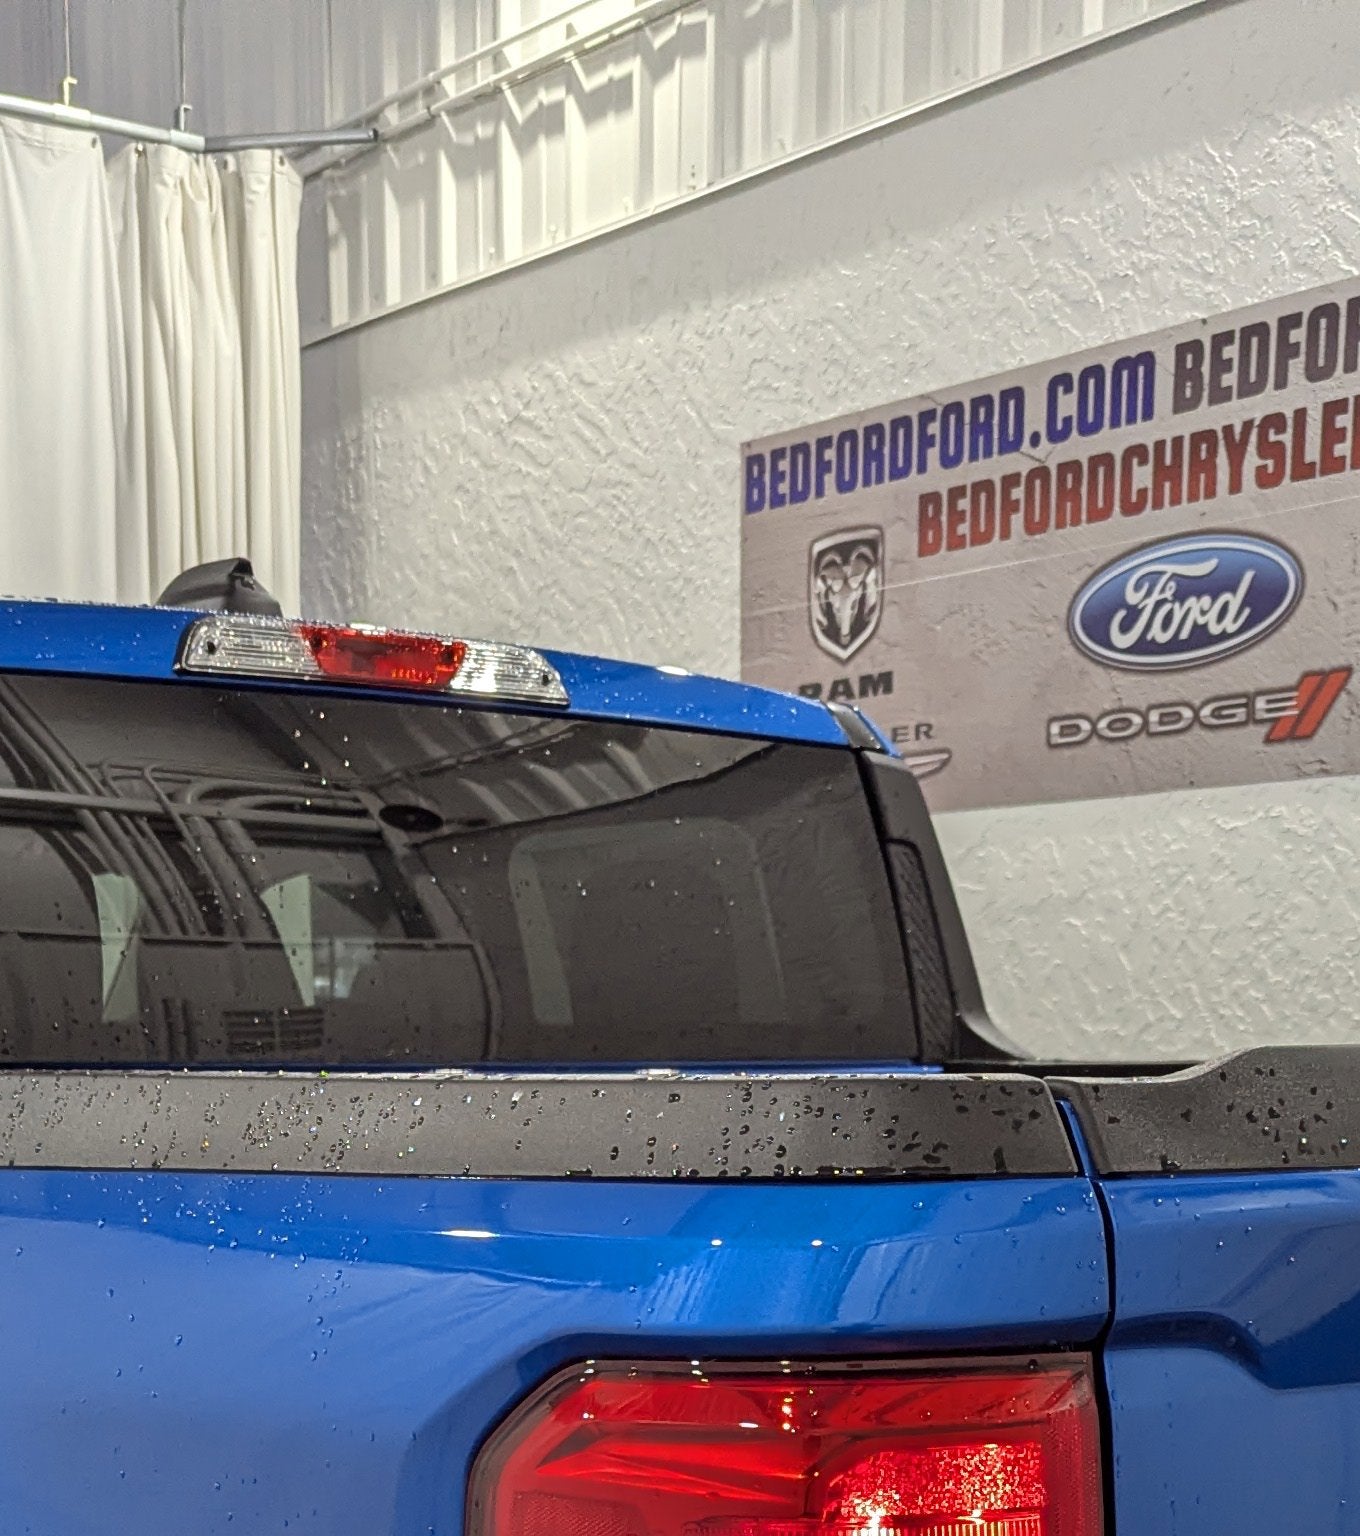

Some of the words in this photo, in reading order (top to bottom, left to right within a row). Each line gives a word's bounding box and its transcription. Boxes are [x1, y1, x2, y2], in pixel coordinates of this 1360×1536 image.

[744, 350, 1157, 515] BEDFORDFORD.COM
[1109, 558, 1256, 650] Ford
[1047, 688, 1302, 748] DODGE
